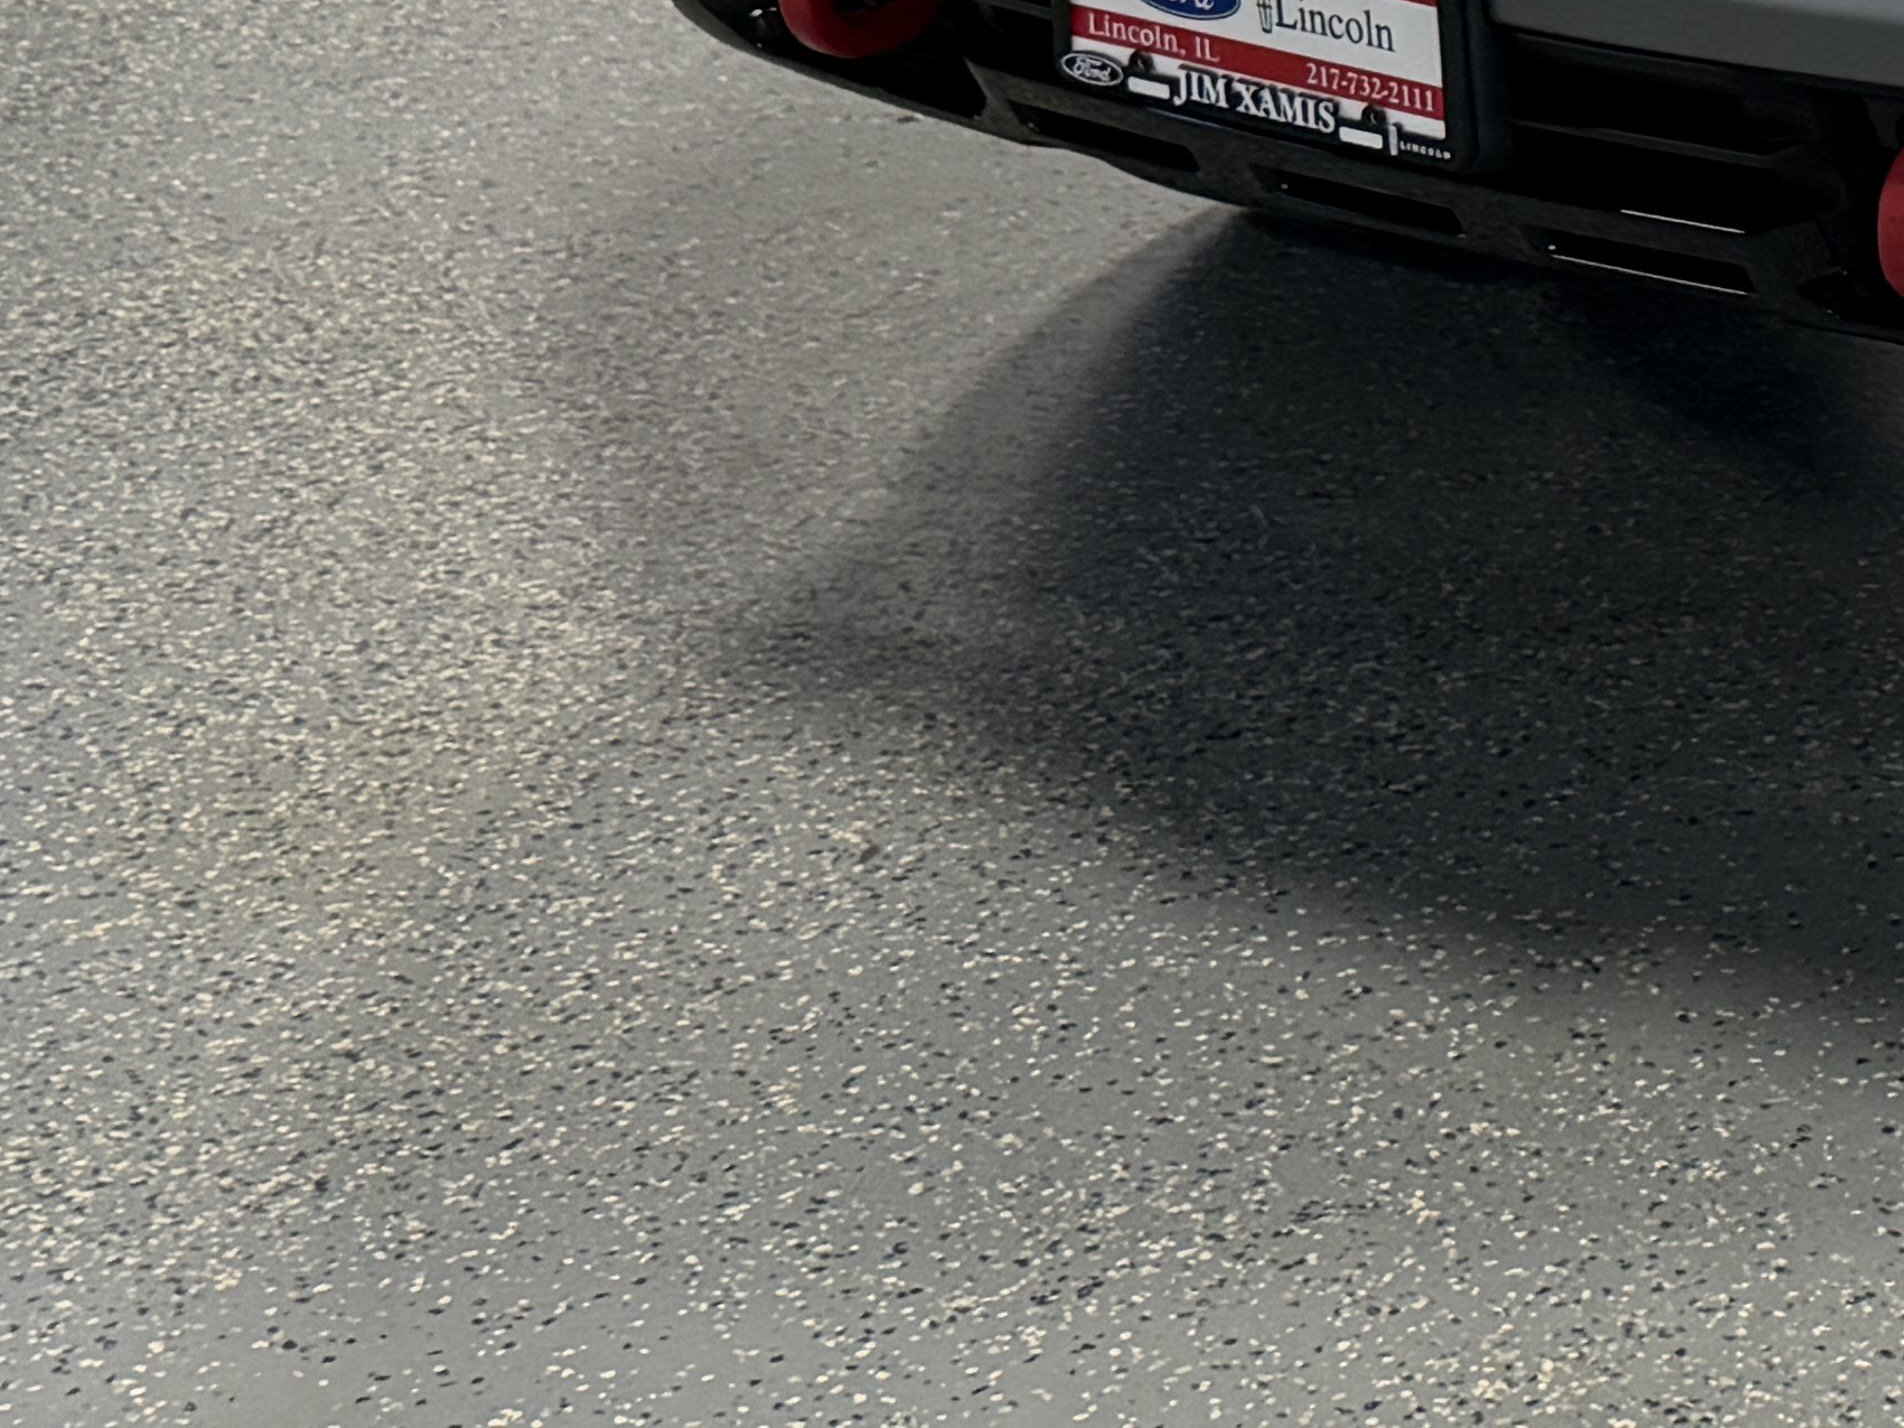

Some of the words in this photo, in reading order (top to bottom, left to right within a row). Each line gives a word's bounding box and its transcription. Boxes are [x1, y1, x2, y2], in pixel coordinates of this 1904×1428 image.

[1195, 35, 1221, 62] IL
[1173, 70, 1228, 111] JIM
[1236, 81, 1337, 134] XAMIS
[1306, 61, 1434, 112] 217-732-2111
